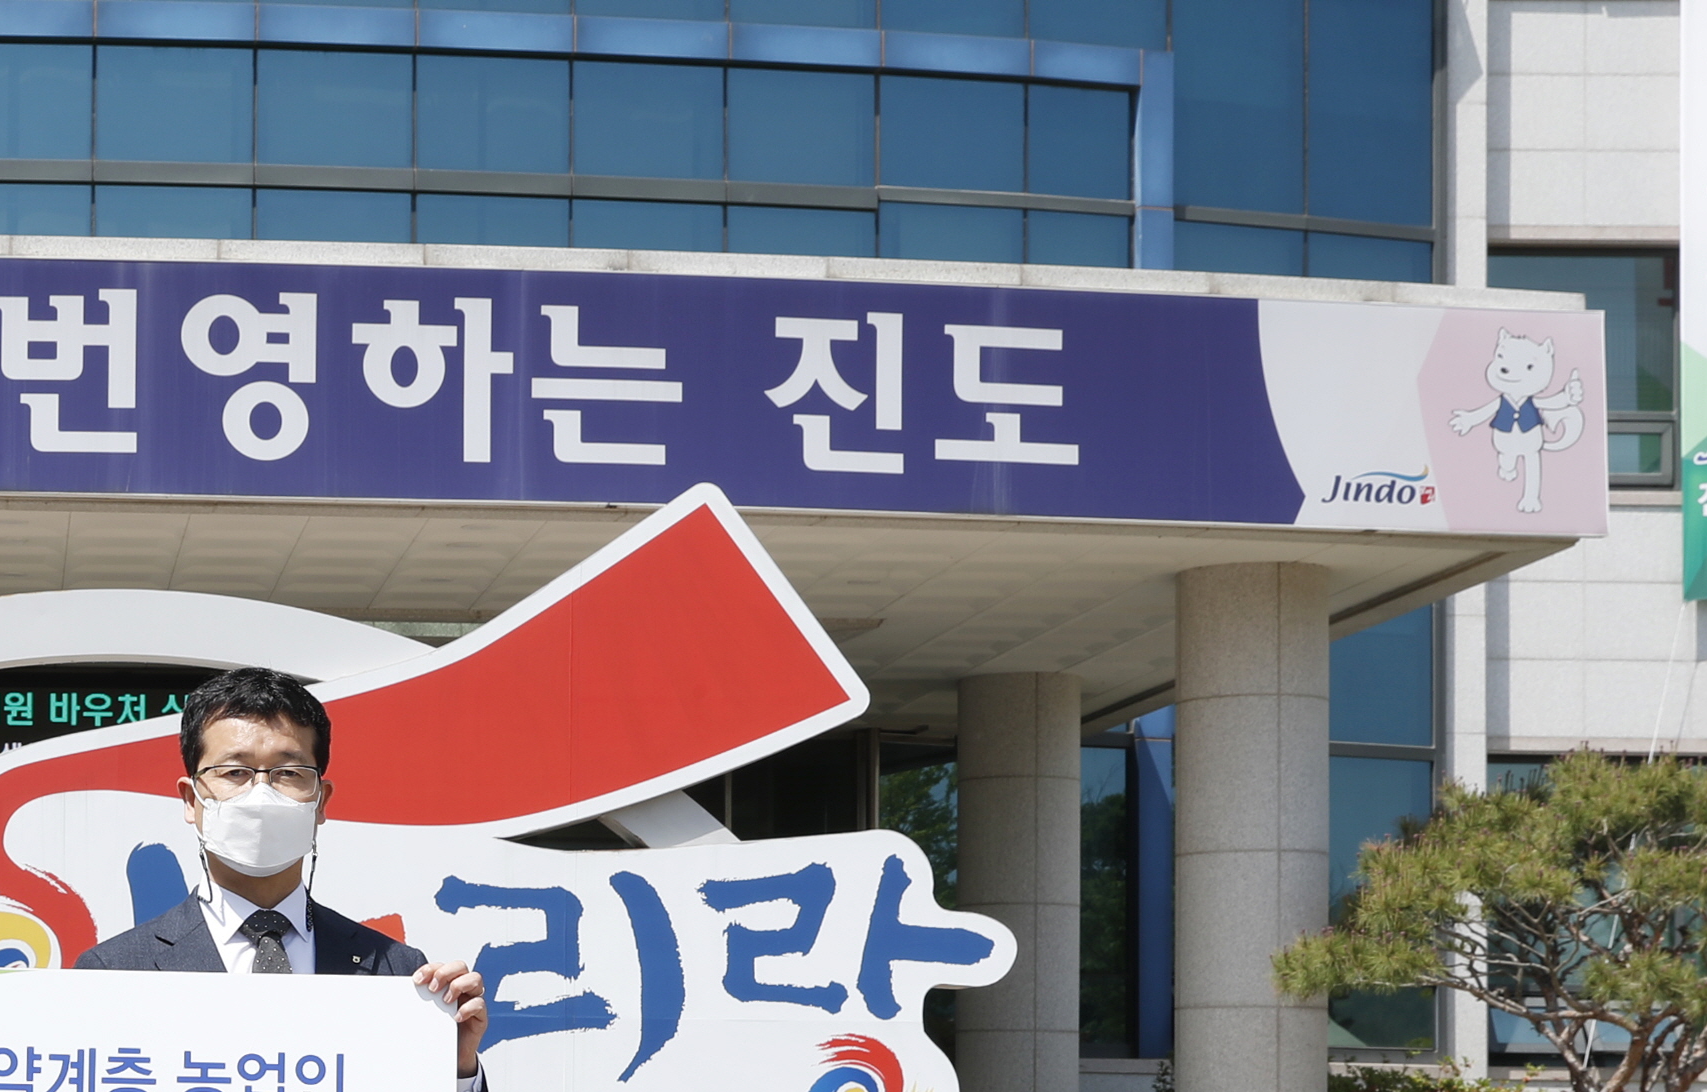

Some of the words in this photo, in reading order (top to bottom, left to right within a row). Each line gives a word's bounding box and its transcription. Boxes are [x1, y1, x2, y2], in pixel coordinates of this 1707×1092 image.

[764, 312, 1079, 474] 진도
[1321, 475, 1416, 504] Jindo
[50, 693, 146, 726] 바우처
